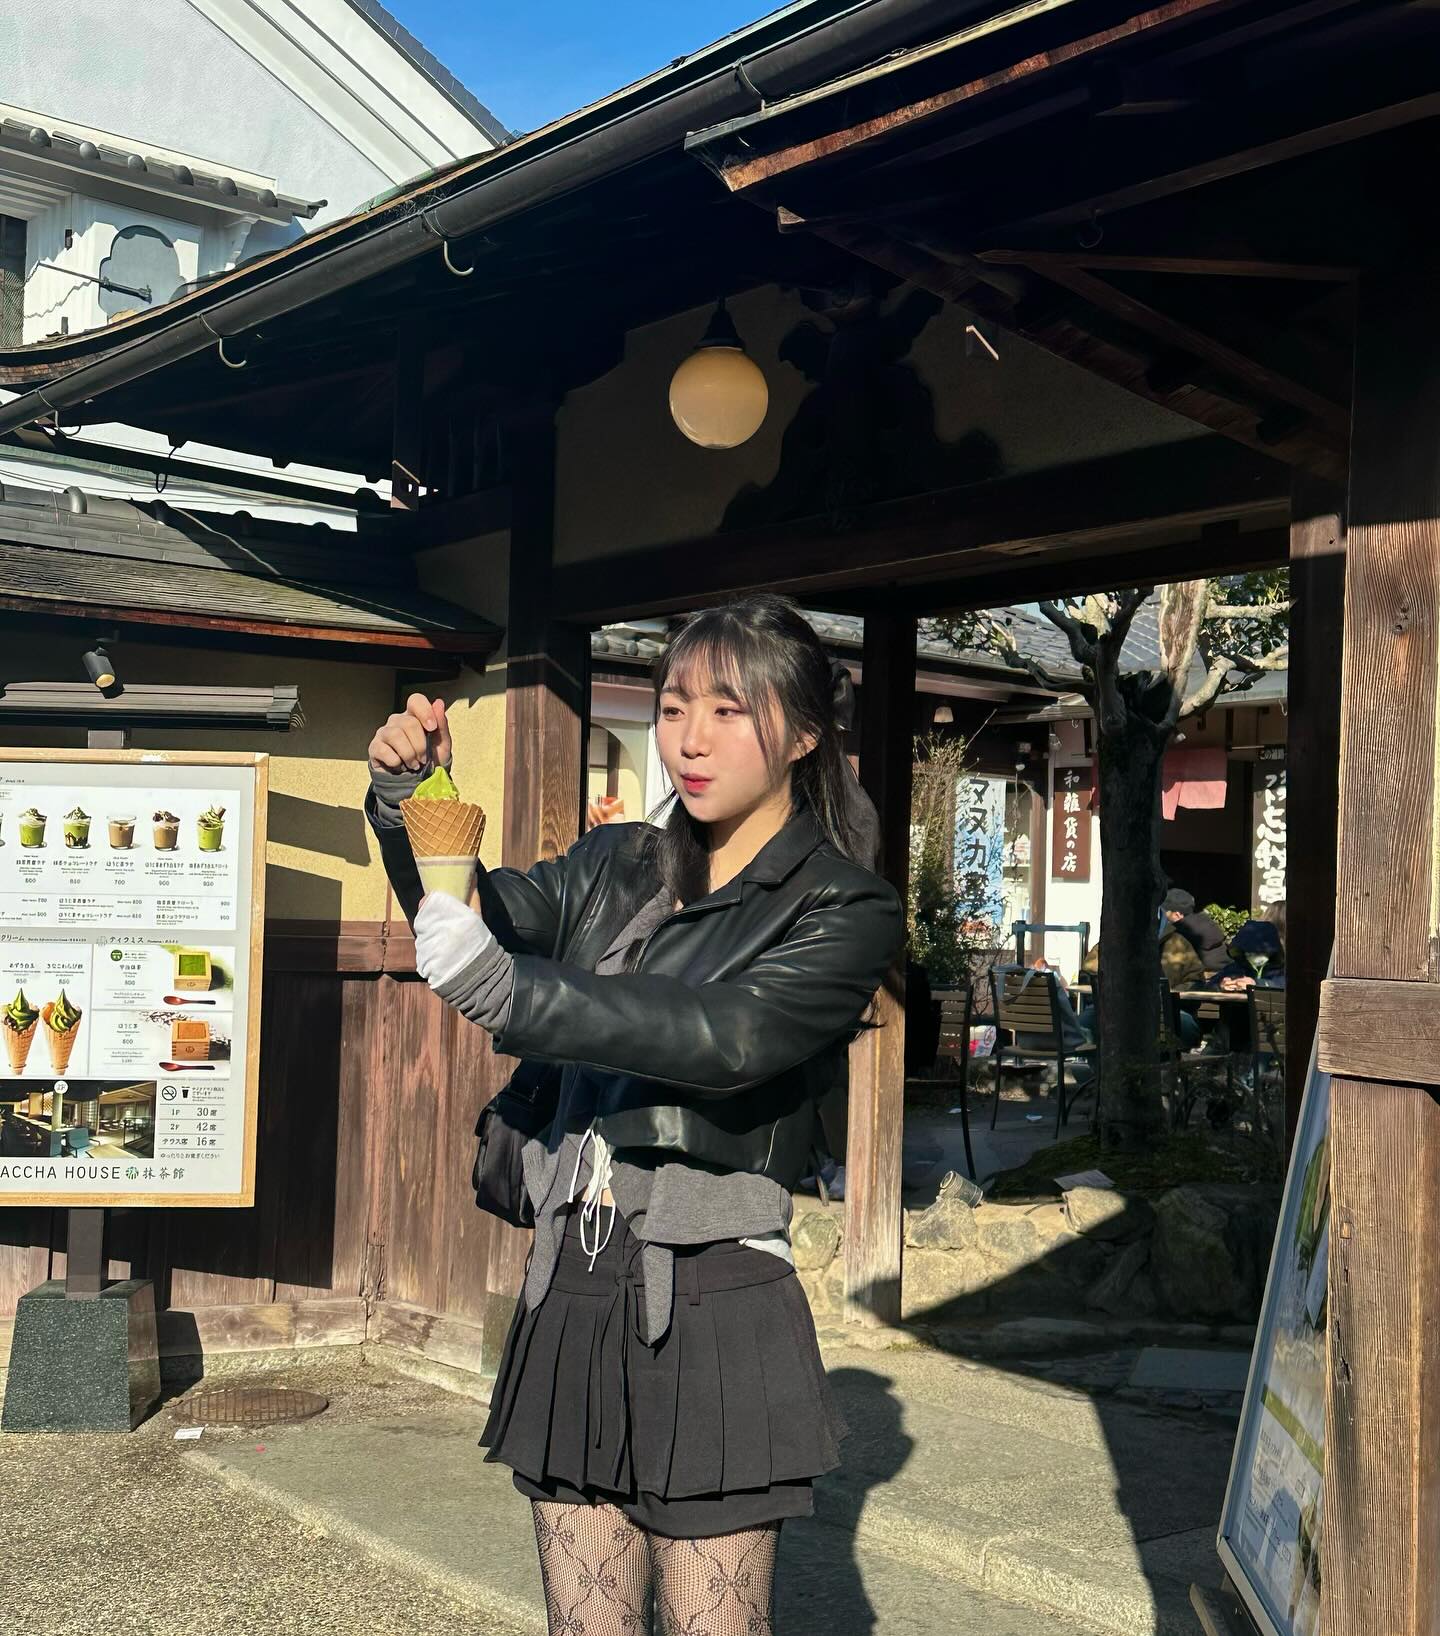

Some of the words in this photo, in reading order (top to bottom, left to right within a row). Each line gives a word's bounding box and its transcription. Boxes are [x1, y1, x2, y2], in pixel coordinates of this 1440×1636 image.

[1061, 769, 1080, 873] 和雑貨の店
[0, 1165, 57, 1179] ACCHA
[65, 1166, 121, 1180] HOUSE
